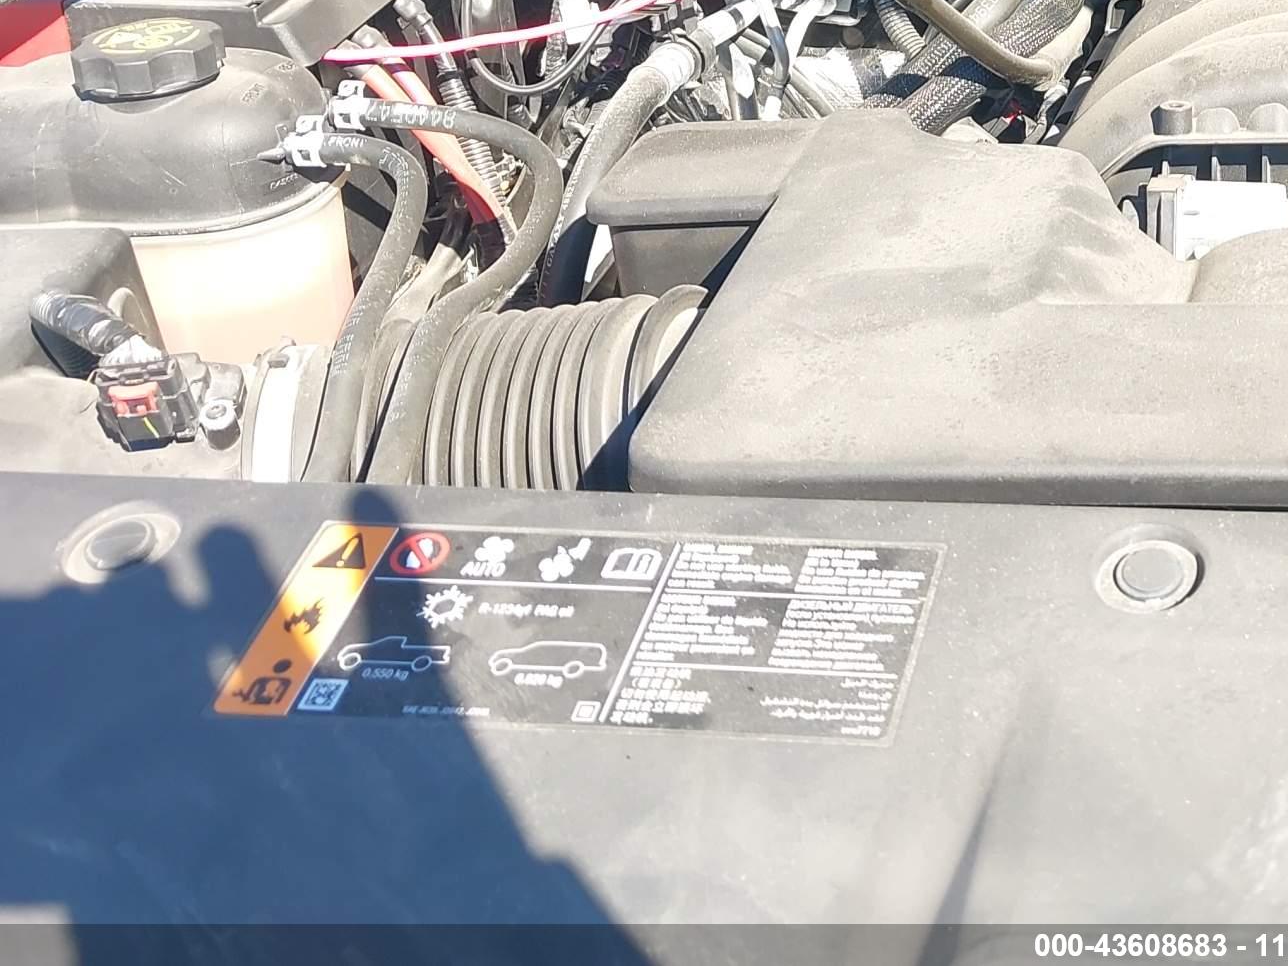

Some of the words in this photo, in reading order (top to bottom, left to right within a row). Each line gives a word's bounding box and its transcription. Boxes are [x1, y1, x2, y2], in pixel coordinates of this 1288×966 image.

[460, 561, 506, 577] AUTO
[361, 667, 393, 679] 0.550
[393, 667, 409, 682] kg
